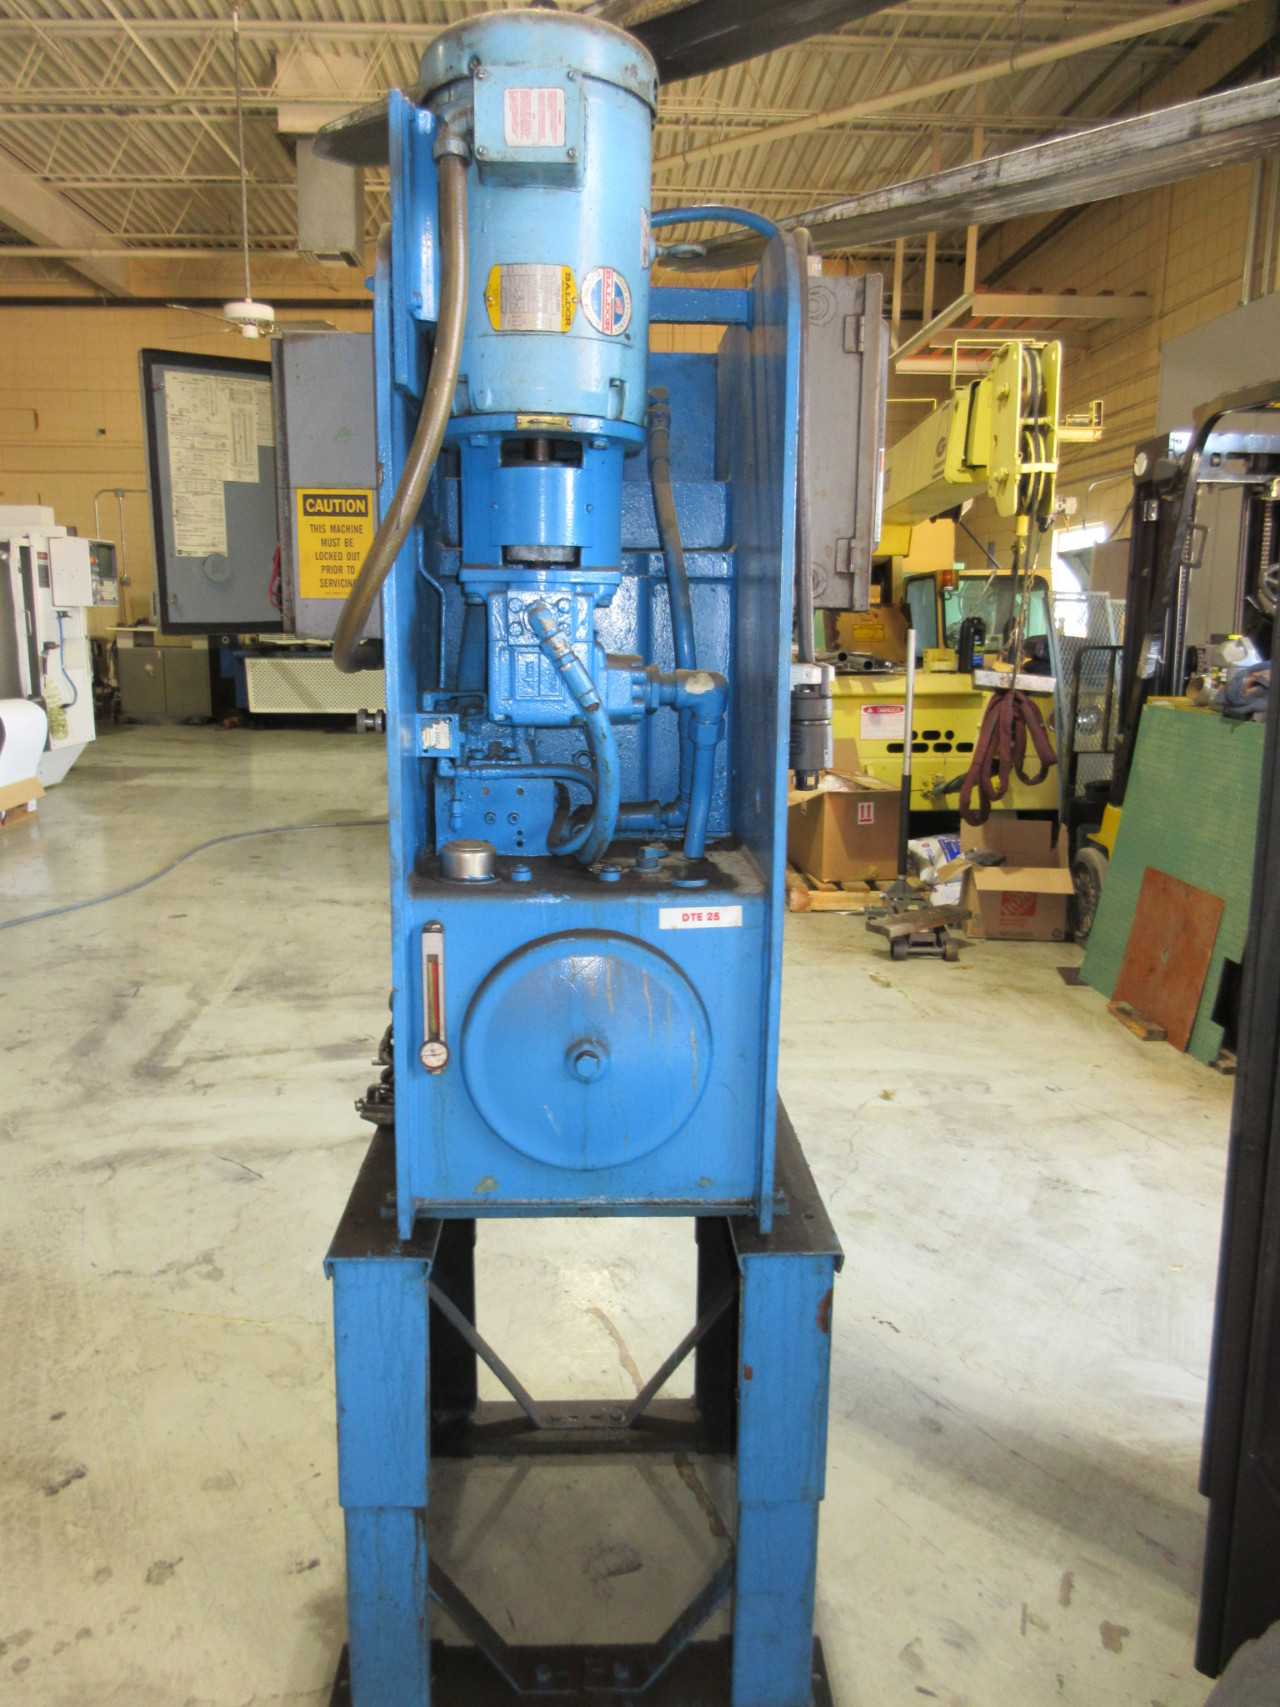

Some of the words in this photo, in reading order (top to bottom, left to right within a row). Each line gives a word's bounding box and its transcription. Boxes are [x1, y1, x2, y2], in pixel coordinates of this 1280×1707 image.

[305, 498, 366, 513] CAUTION
[310, 524, 327, 534] THIS
[330, 524, 363, 534] MACHINE
[320, 538, 341, 548] MUST
[344, 538, 354, 548] BE
[315, 552, 343, 561] LOCKED
[346, 552, 360, 561] OUT
[320, 565, 344, 575] PRIOR
[346, 565, 356, 575] TO
[319, 579, 354, 589] SERVICIN
[681, 912, 703, 922] DTE
[706, 911, 721, 921] 25
